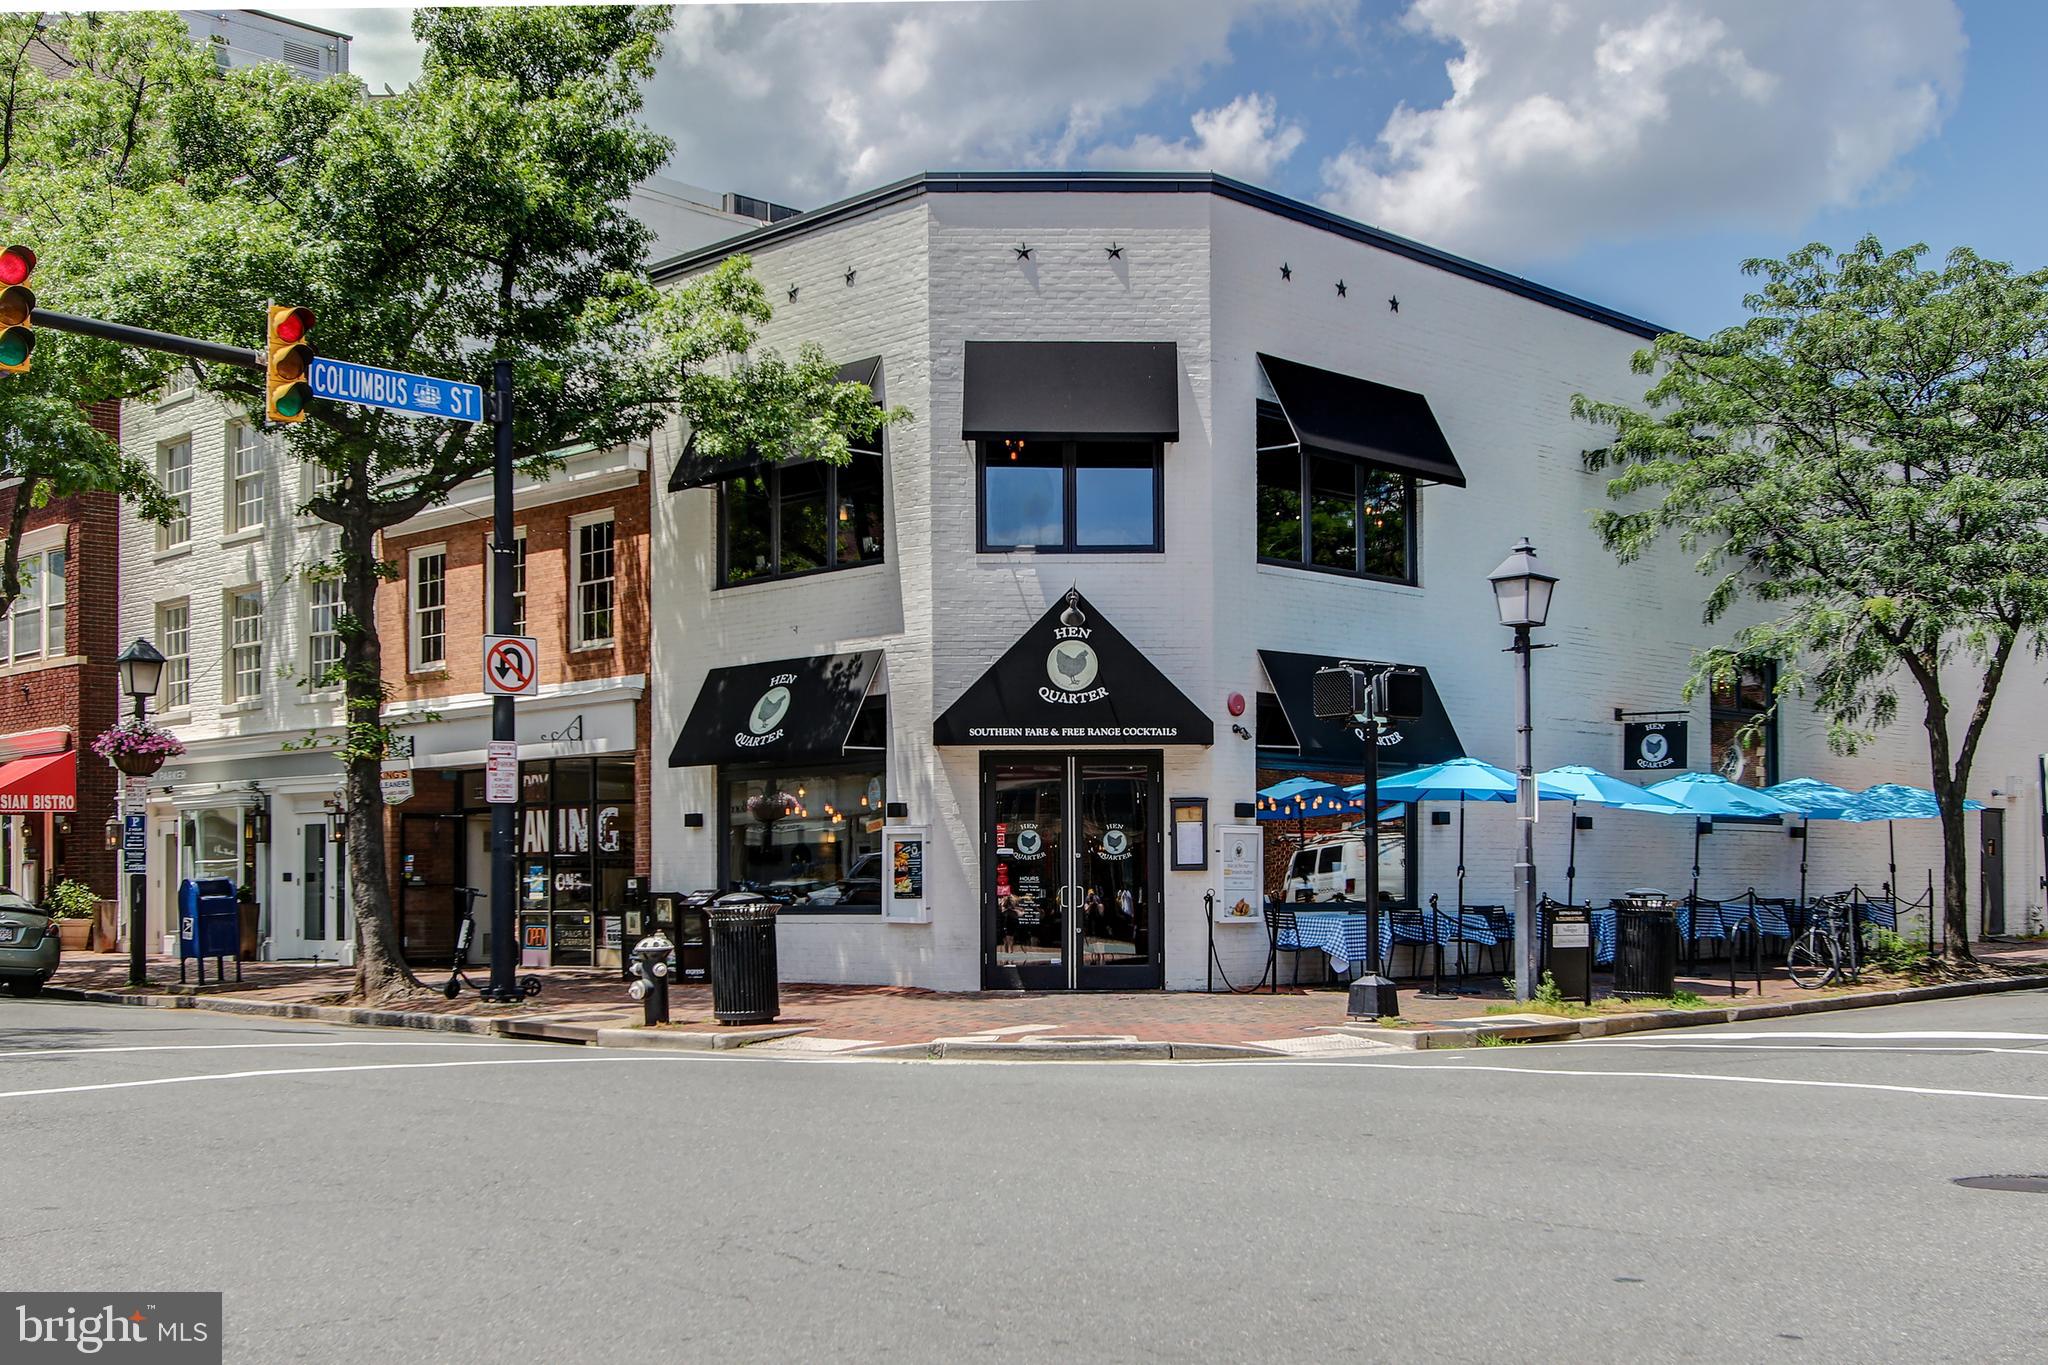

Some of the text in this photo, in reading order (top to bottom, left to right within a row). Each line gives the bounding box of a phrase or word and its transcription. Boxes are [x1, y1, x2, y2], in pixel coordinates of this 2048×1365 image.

[315, 363, 408, 405] COLUMBUS
[450, 387, 473, 416] ST
[1054, 626, 1092, 639] HEN
[769, 674, 797, 687] HEN
[1038, 686, 1109, 704] QUARTER
[735, 729, 784, 747] QUARTER
[969, 727, 1177, 737] SOUTHERN FARE & FREE RANGE COCKTAILS
[1355, 728, 1403, 746] QRTER
[1637, 758, 1675, 768] QUARTER
[0, 794, 74, 810] SIAN BISTRO
[132, 816, 140, 827] P
[514, 807, 620, 852] ANING
[1013, 851, 1047, 860] QUARTER
[1097, 852, 1132, 860] QUARTER
[527, 928, 547, 946] OPEN
